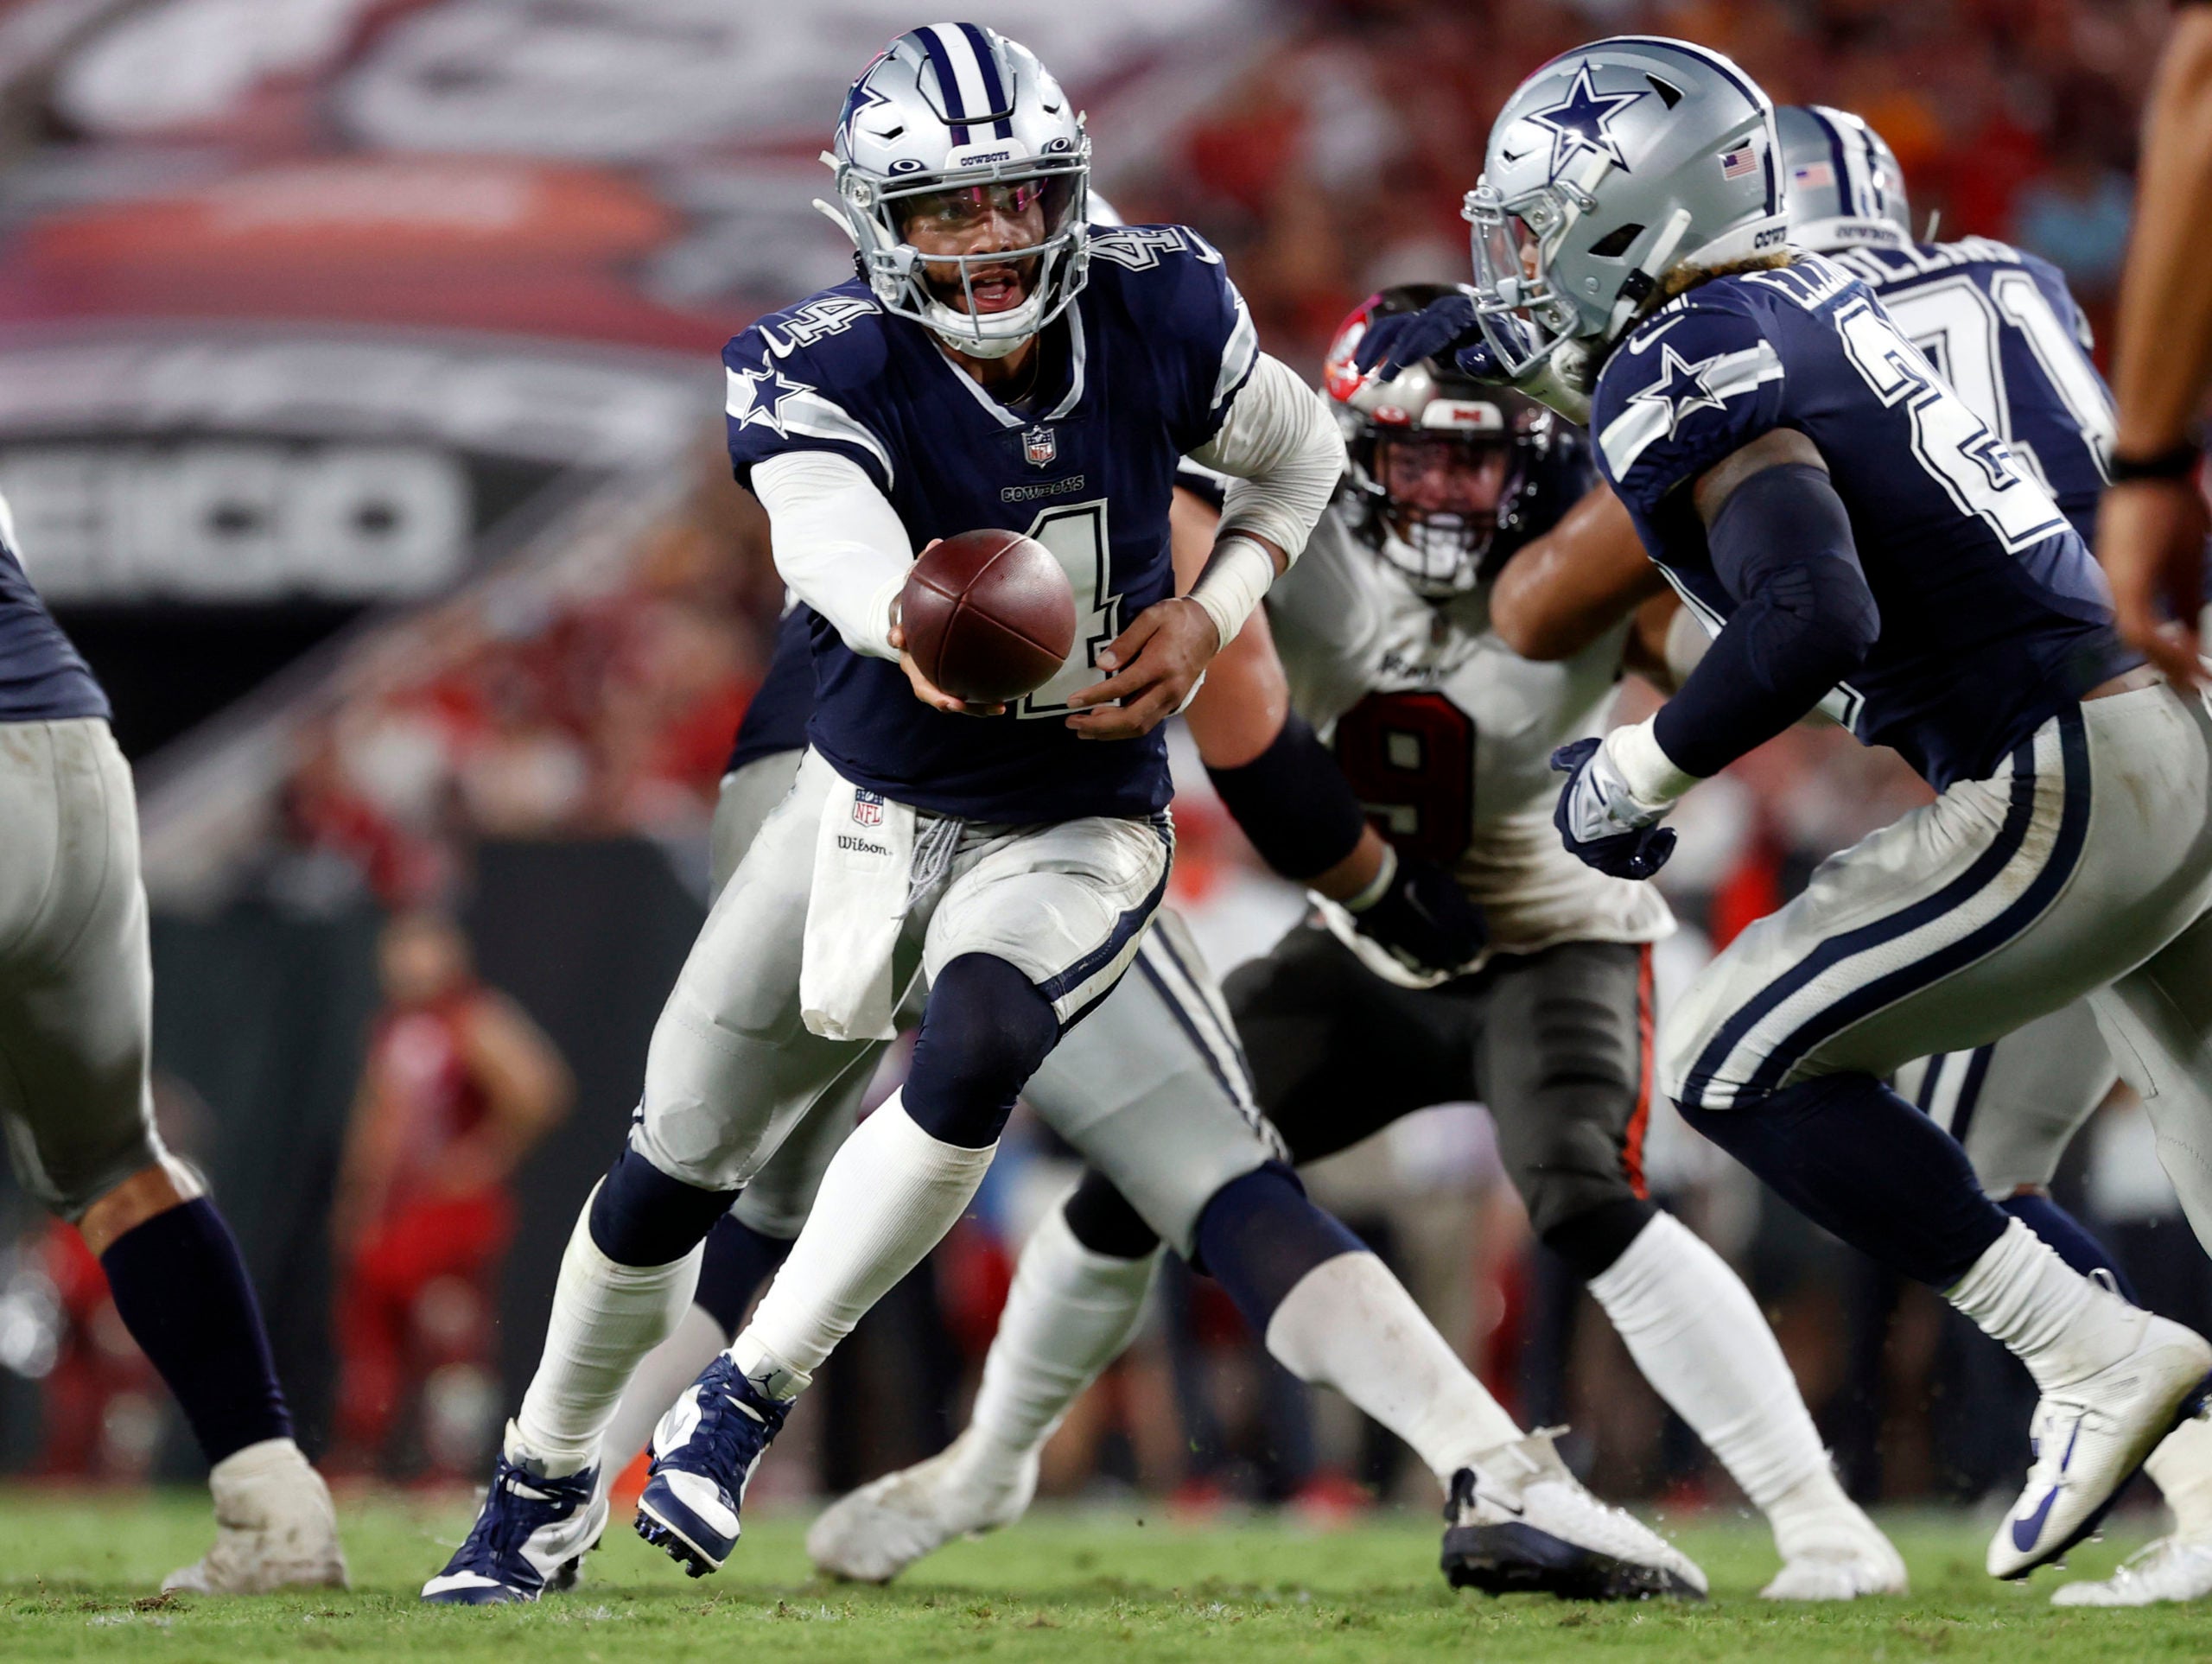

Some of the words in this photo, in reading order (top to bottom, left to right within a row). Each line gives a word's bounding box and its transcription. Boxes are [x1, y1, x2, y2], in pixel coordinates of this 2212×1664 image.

[960, 151, 1010, 167] COWBOYS
[1088, 226, 1188, 272] 4
[777, 295, 883, 348] 4
[1001, 474, 1085, 502] COWBOYS
[0, 442, 468, 603] EICO
[855, 802, 880, 824] NFL
[837, 835, 887, 856] Wilson
